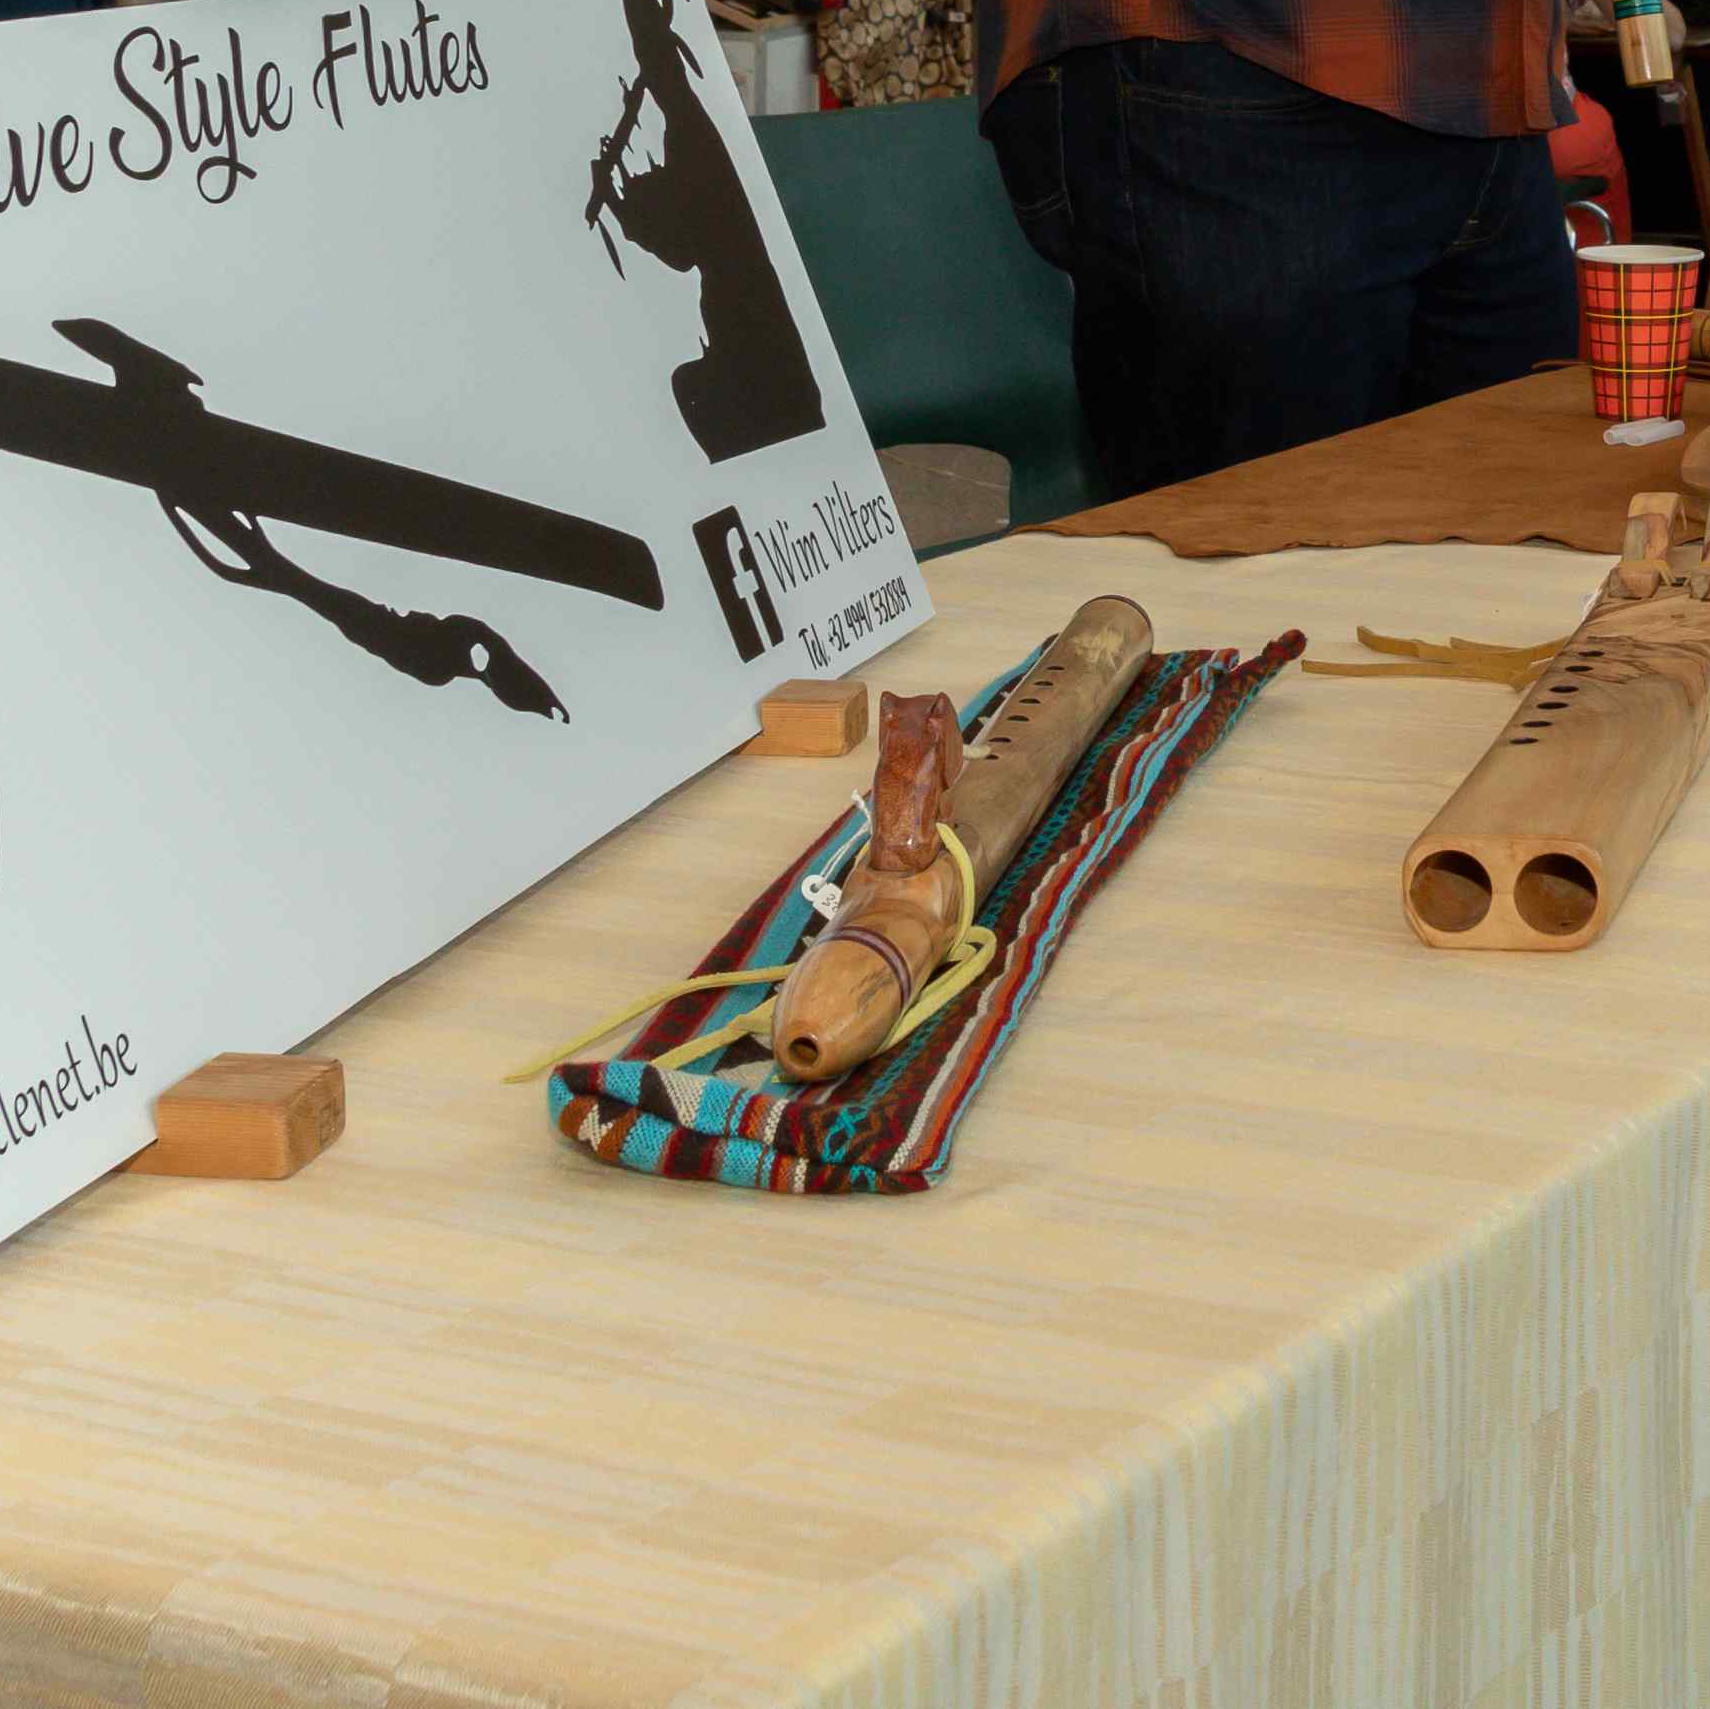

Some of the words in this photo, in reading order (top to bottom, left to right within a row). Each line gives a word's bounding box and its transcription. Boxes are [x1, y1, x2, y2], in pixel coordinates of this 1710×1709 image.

[108, 26, 292, 204] Style
[755, 519, 829, 593] Wim
[812, 481, 895, 562] Vilters
[798, 623, 831, 670] Tel.
[829, 613, 850, 652] +32
[870, 576, 912, 626] 532884
